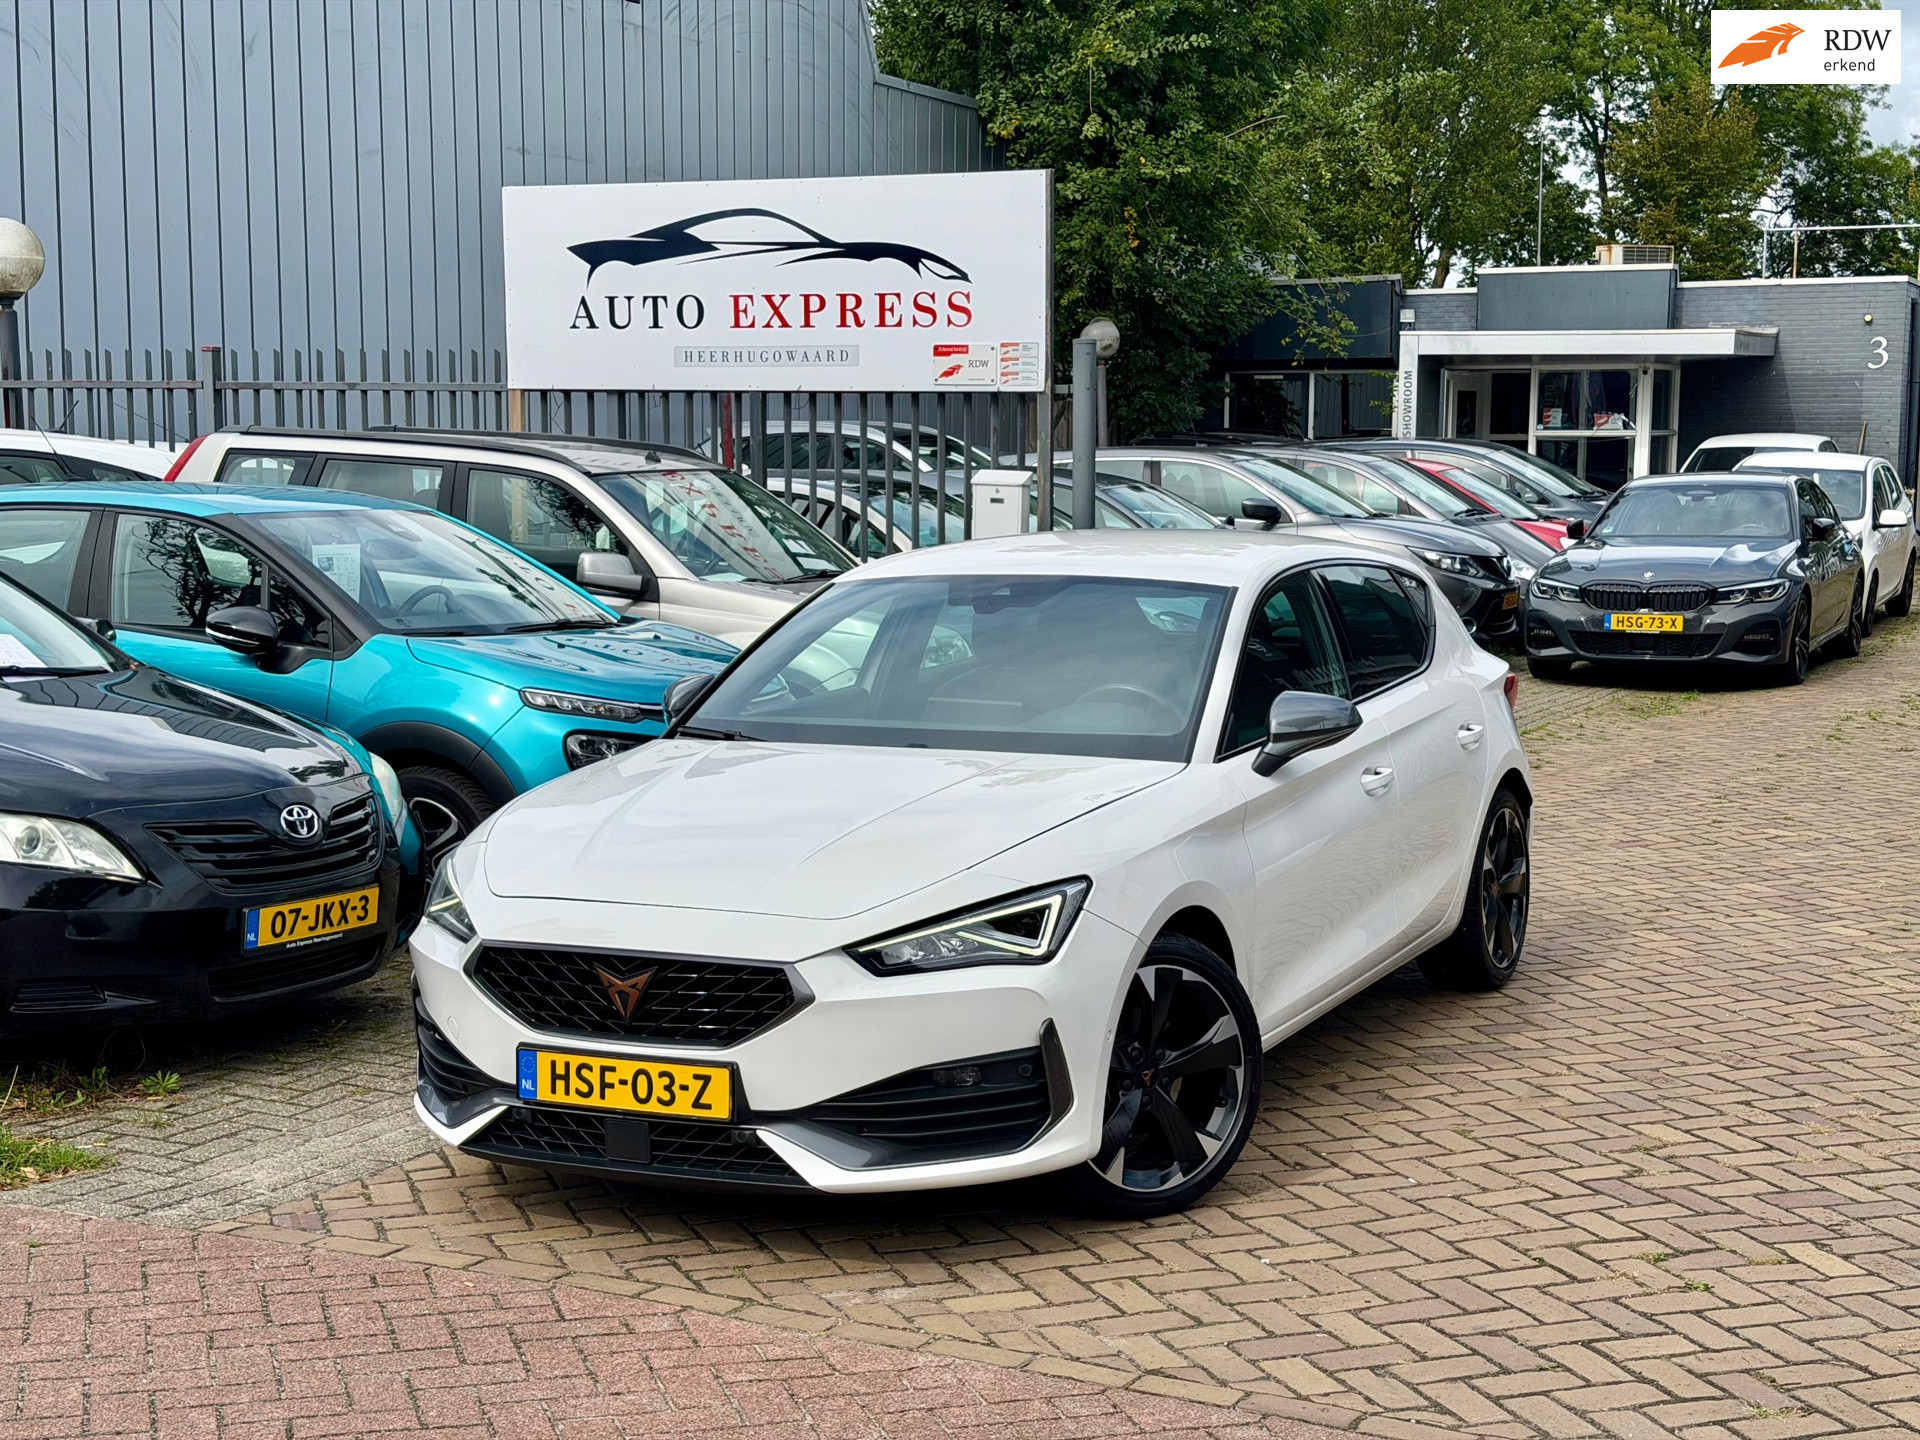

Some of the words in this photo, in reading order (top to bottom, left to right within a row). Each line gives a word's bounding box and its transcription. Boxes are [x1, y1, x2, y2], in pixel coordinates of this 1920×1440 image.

[569, 294, 705, 330] AUTO
[729, 291, 973, 329] EXPRESS
[684, 349, 850, 364] HEERHUGOWAARD
[968, 359, 990, 368] RDW
[1867, 336, 1889, 369] 3
[1402, 370, 1413, 438] SHOWROOM
[1616, 615, 1678, 630] HSG-73-X
[247, 932, 257, 942] NL
[270, 894, 370, 939] 07-JKX-3
[521, 1079, 536, 1091] NL
[550, 1059, 713, 1111] HSF-03-Z
